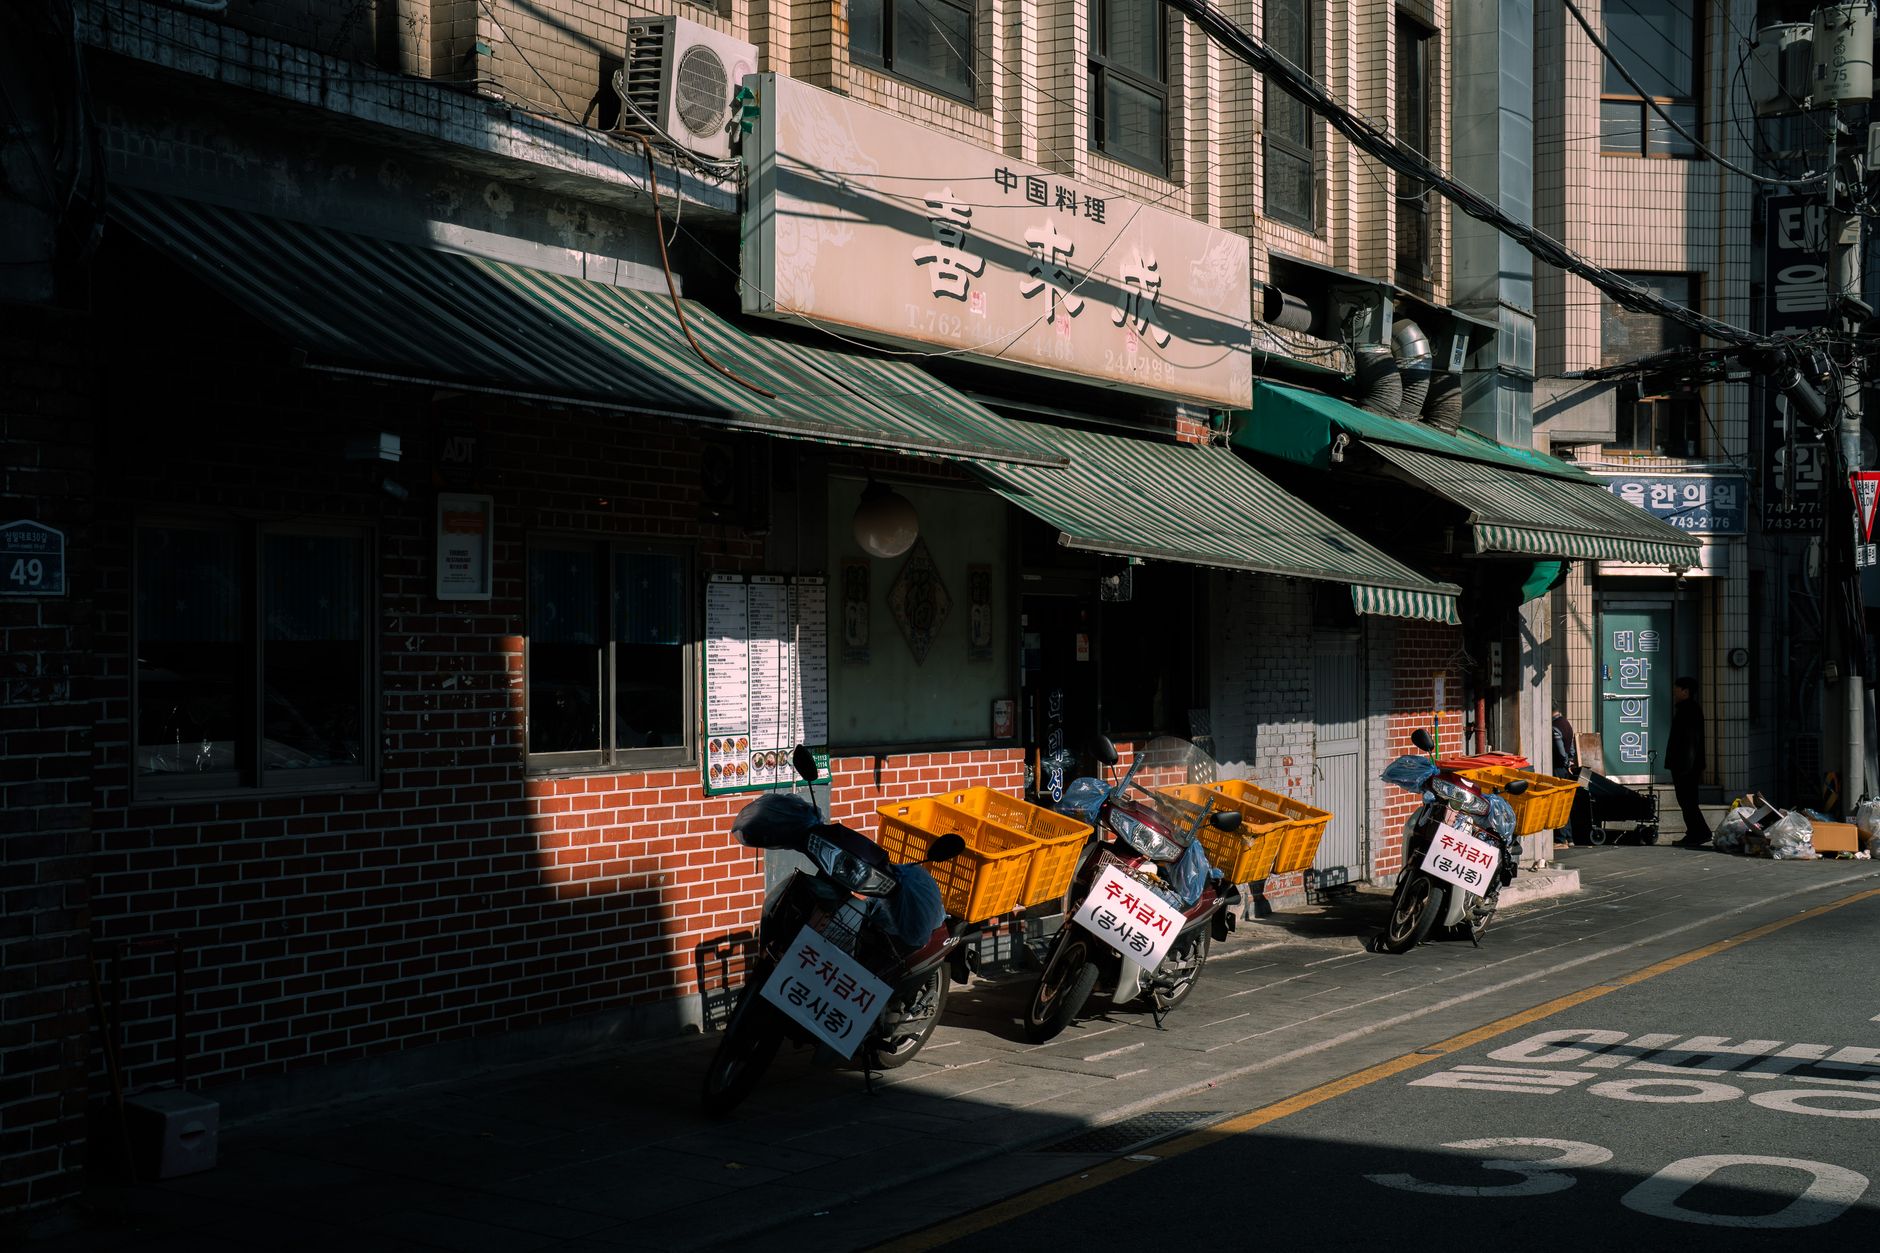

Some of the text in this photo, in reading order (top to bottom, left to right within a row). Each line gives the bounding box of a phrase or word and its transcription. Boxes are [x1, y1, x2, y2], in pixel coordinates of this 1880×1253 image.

[1833, 68, 1848, 82] 75
[994, 166, 1106, 225] 中国料理
[440, 436, 477, 463] ADT
[1603, 482, 1738, 510] 을한의원
[1669, 515, 1730, 530] 743-2176
[10, 558, 43, 586] 49
[1613, 629, 1661, 653] 태을
[1619, 656, 1652, 763] 한의원
[1433, 853, 1483, 887] (공사중)
[1440, 833, 1494, 870] 주차금지
[1103, 879, 1173, 938] 주차금지
[1090, 905, 1156, 958] (공사중)
[797, 944, 877, 1013] 주차금지
[779, 974, 854, 1039] (공사중)
[1361, 1136, 1870, 1230] 30
